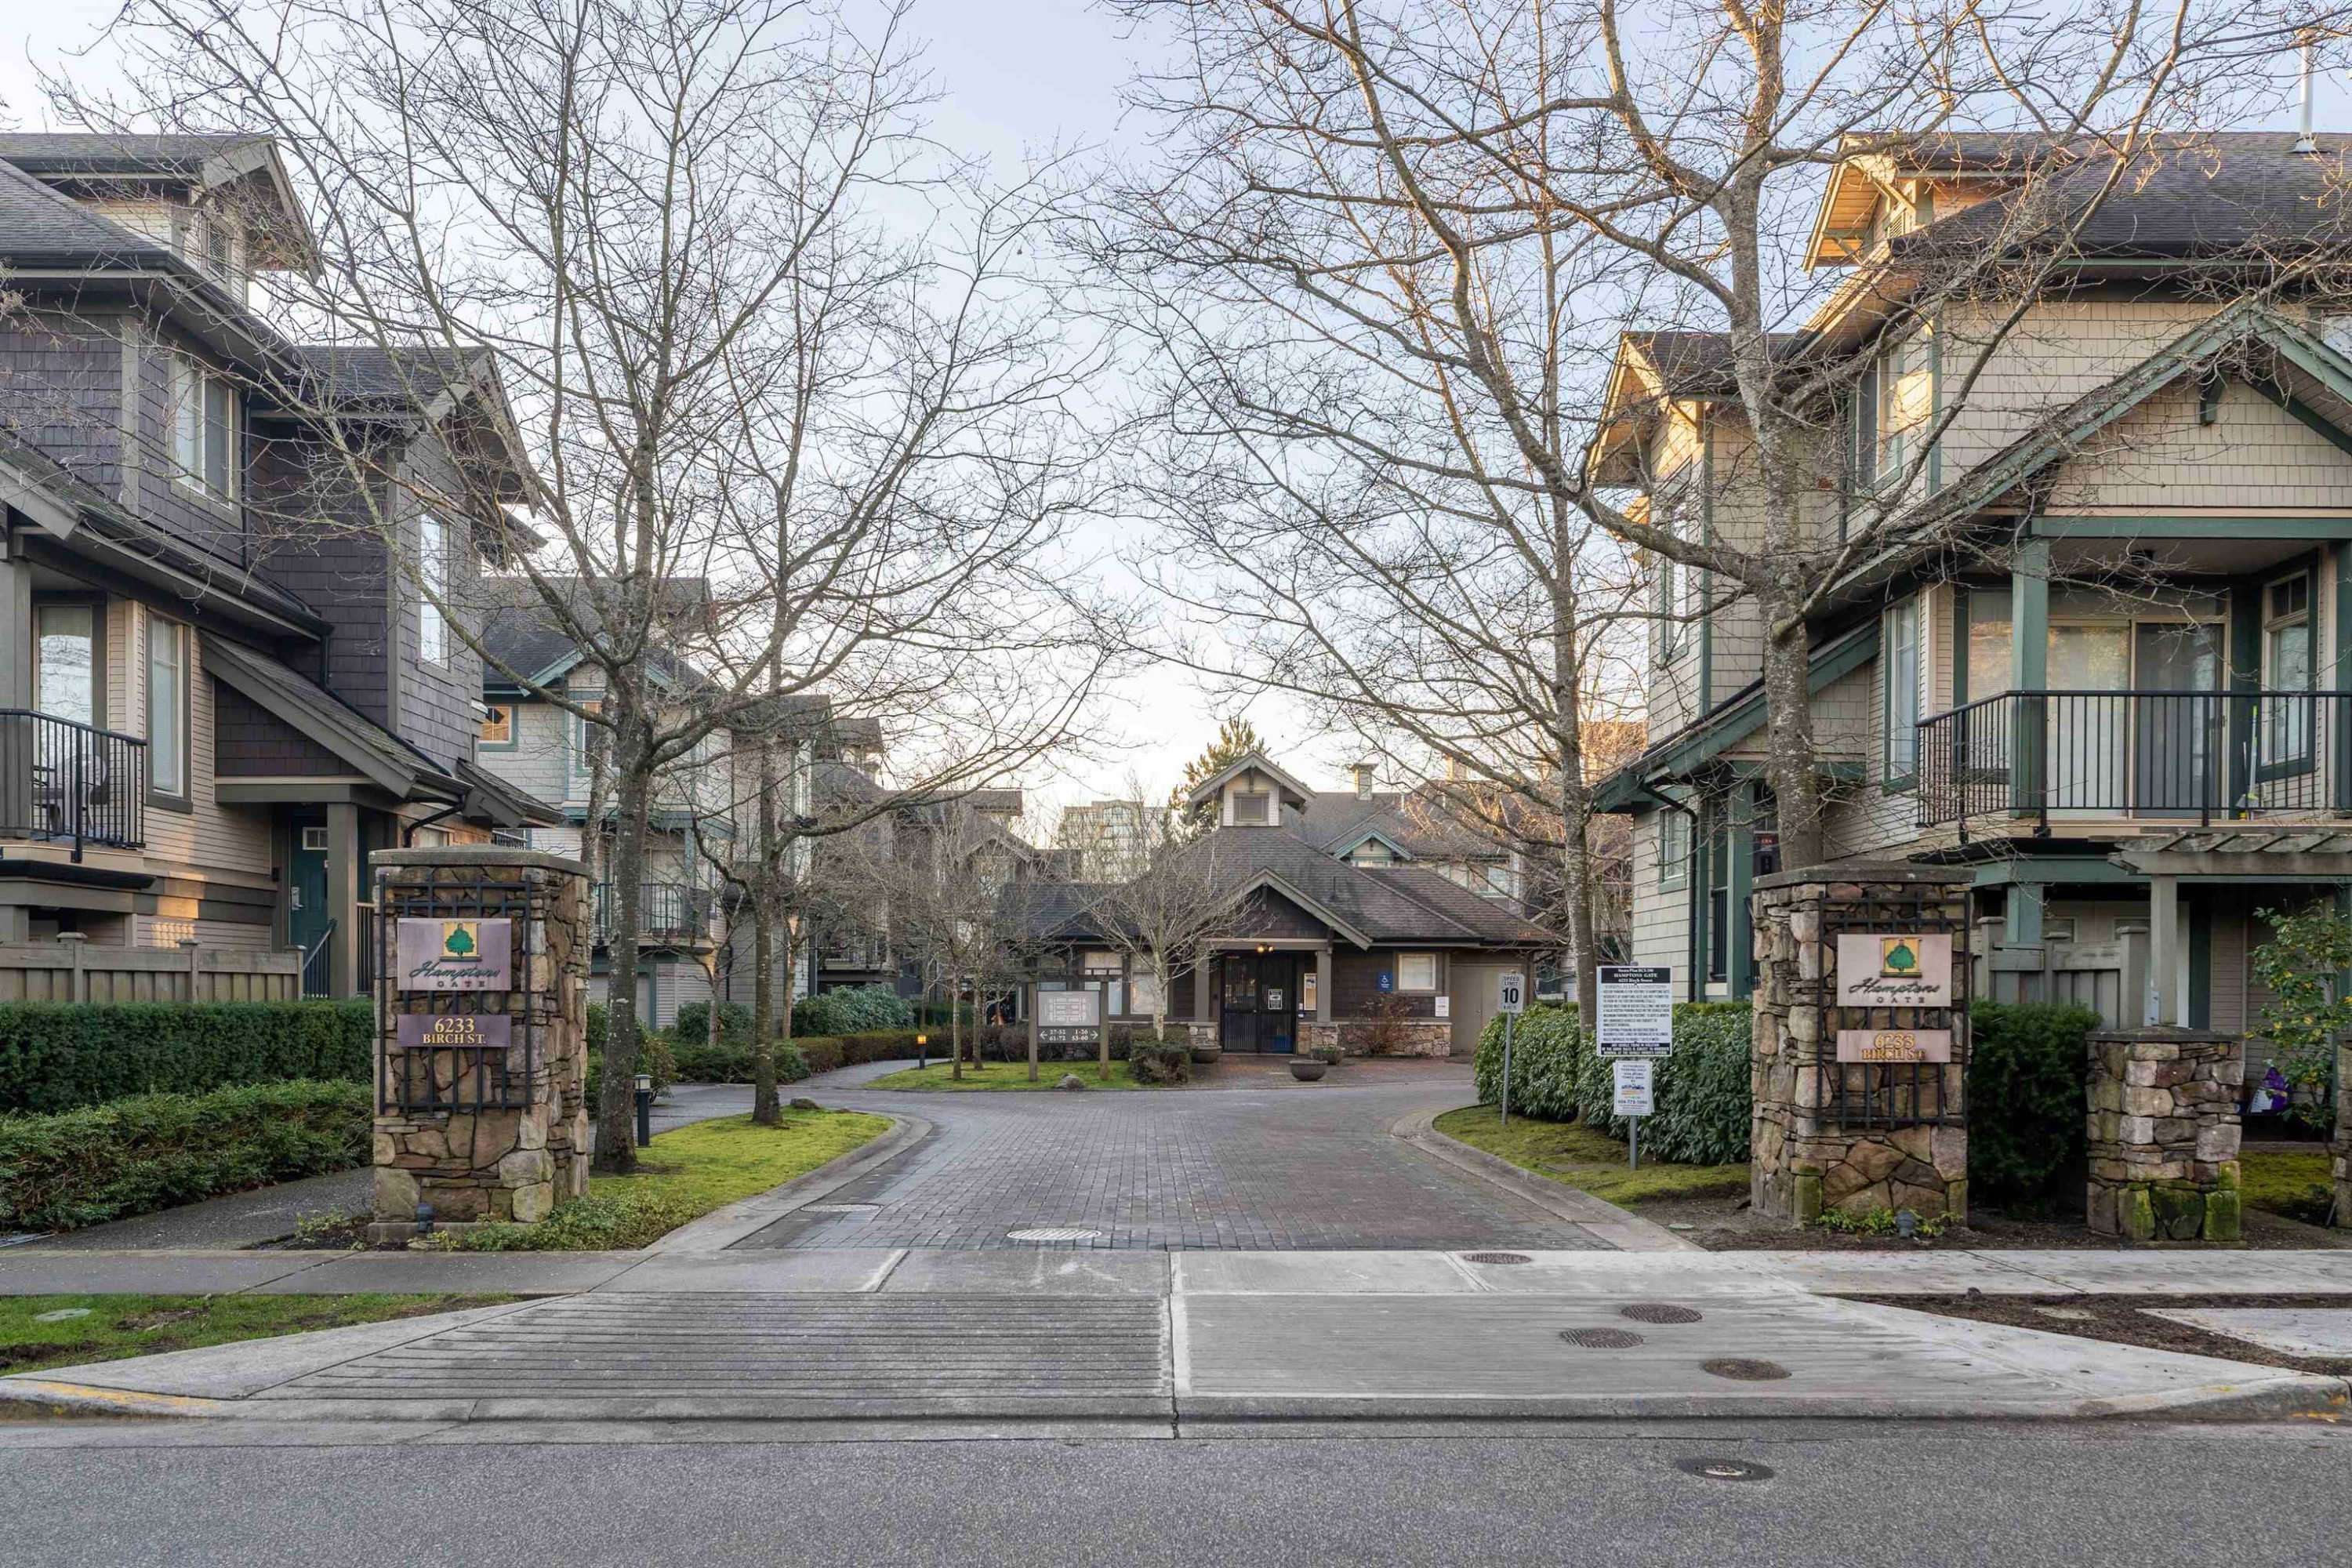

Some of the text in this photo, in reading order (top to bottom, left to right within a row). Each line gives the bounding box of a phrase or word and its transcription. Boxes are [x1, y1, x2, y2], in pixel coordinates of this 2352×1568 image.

[1849, 977, 1940, 996] Hamptons
[1502, 987, 1519, 1004] 10
[434, 1018, 474, 1033] 6233
[423, 1033, 487, 1044] BIRCH ST.
[1875, 1033, 1915, 1049] 6233
[1862, 1048, 1904, 1061] BIRCH
